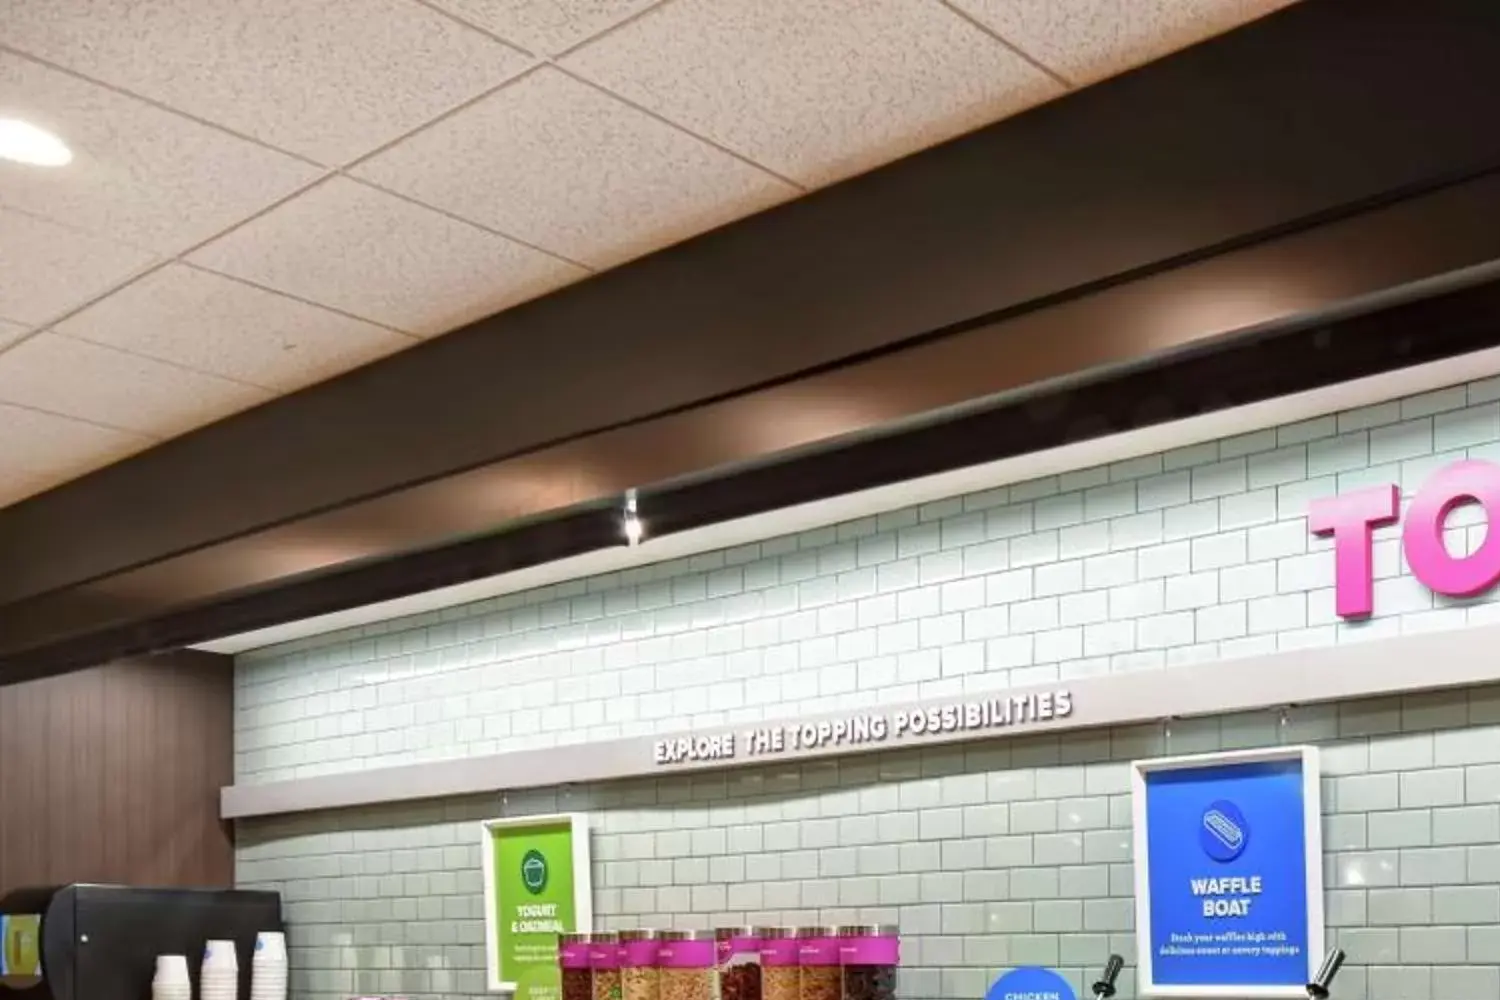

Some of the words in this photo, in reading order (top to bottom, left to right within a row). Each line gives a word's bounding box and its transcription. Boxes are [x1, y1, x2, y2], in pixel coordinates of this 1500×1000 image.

[655, 732, 735, 764] EXPLORE
[744, 727, 784, 755] THE
[790, 713, 887, 750] TOPPING
[895, 690, 1073, 737] POSSIBILITIES
[1190, 876, 1262, 896] WAFFLE
[516, 904, 558, 917] YOGURT
[1203, 899, 1251, 918] BOAT
